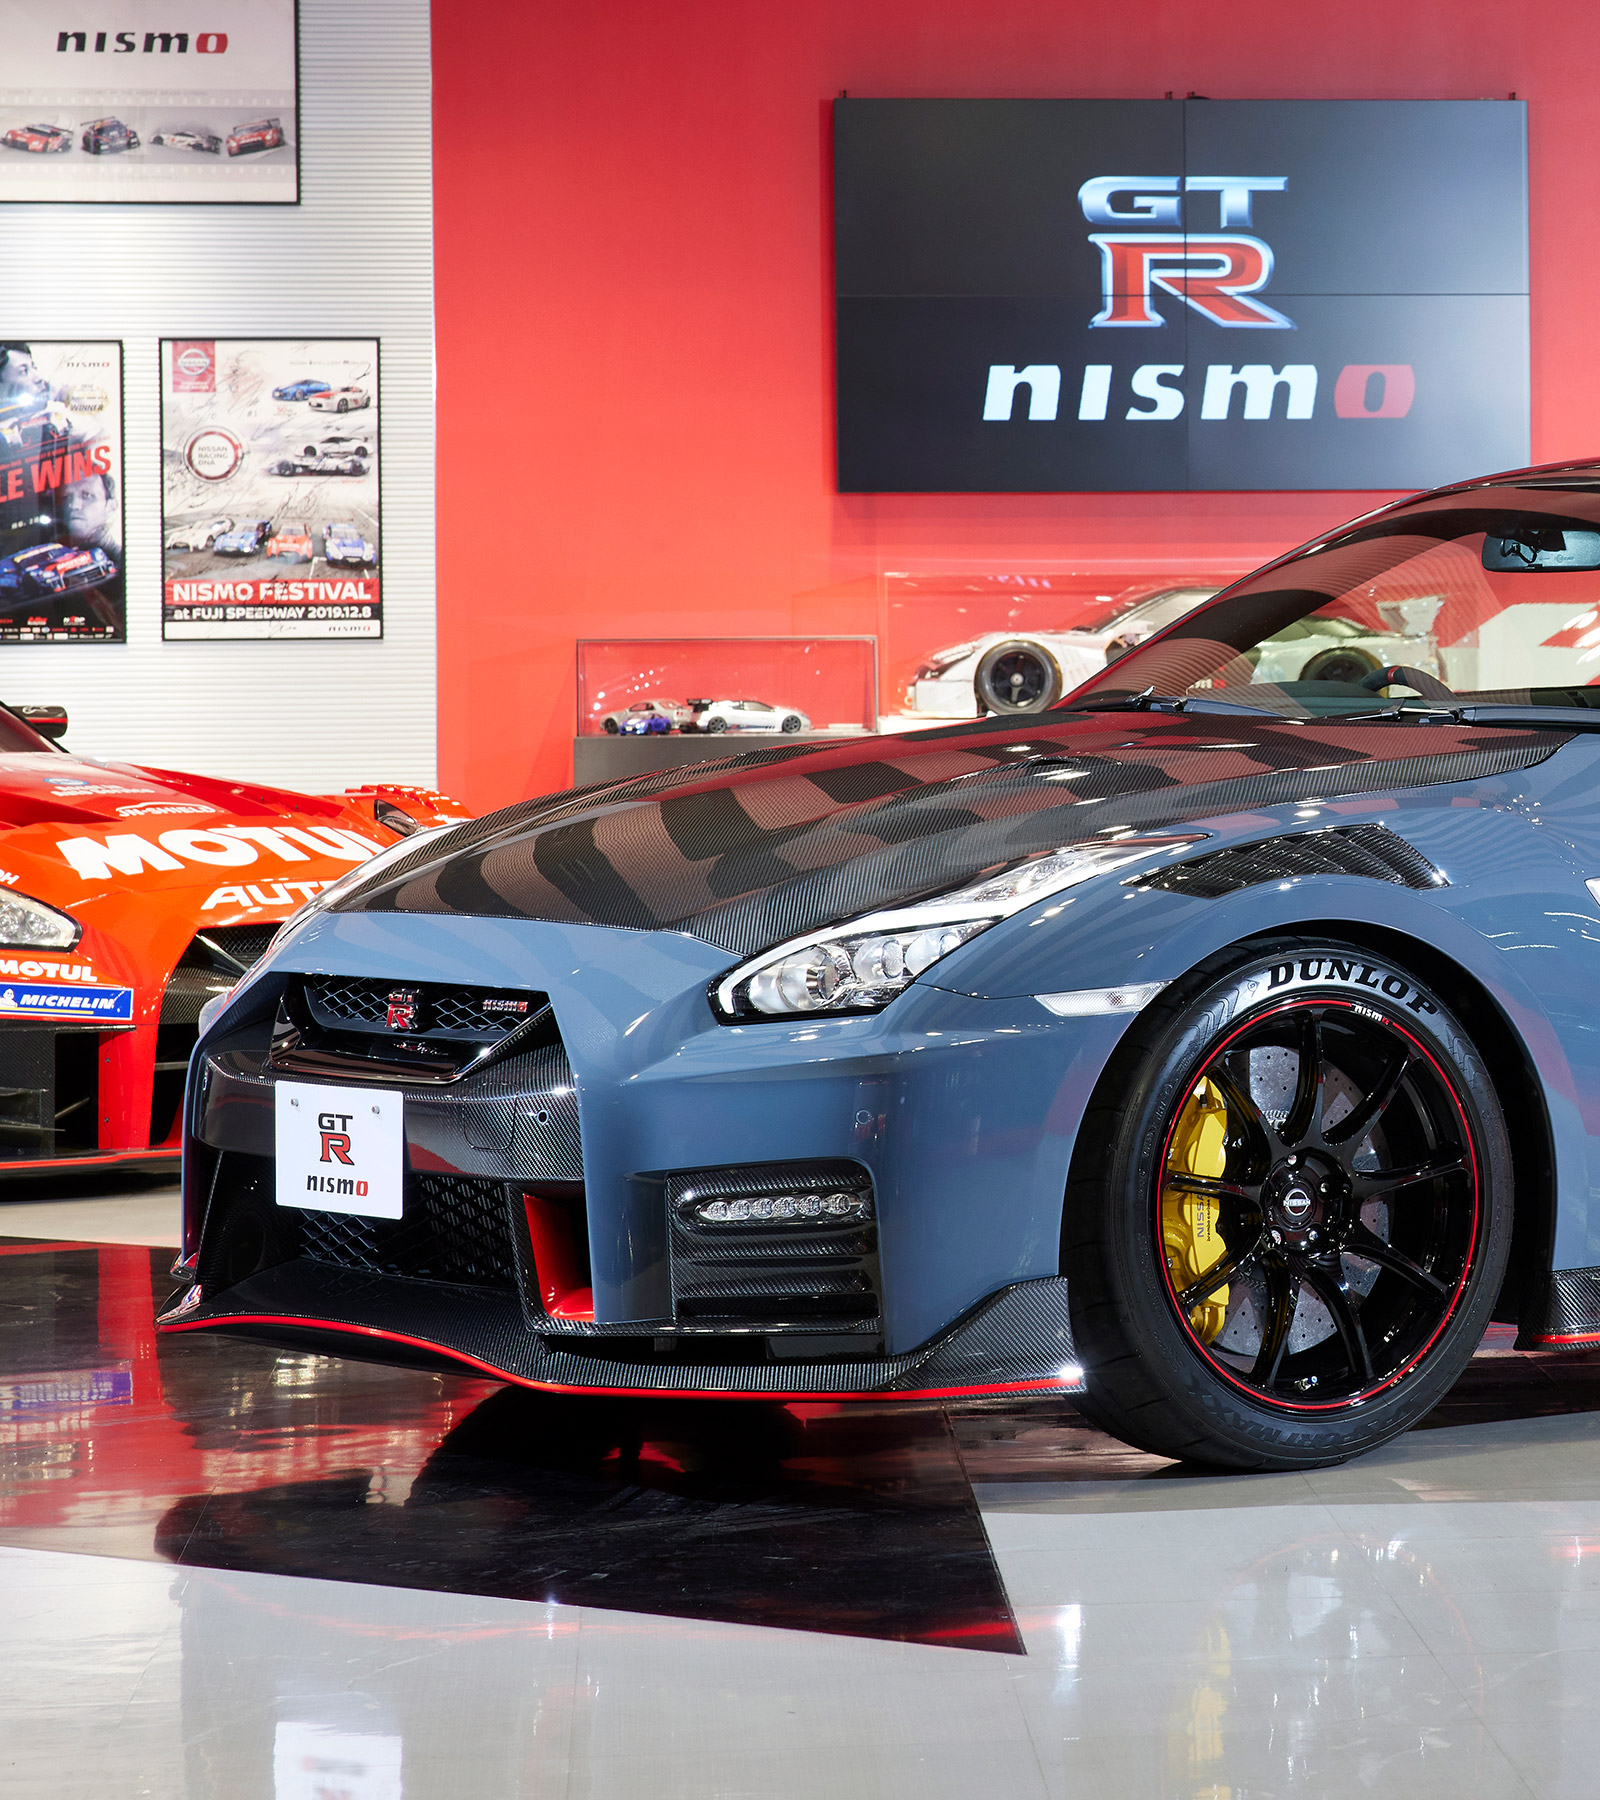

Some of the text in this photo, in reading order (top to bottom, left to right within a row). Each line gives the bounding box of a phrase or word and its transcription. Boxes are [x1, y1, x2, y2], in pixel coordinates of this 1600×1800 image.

[57, 31, 228, 54] nismo
[1077, 175, 1288, 228] GT
[1087, 233, 1298, 330] R
[983, 364, 1416, 421] nismo
[31, 445, 111, 494] WINS
[173, 582, 372, 602] NISMO FESTIVAL
[173, 606, 372, 620] at FUJI SPEEDWAY 2019.12.8
[0, 959, 98, 983] MOTUL
[1268, 957, 1438, 1017] DUNLOP
[20, 994, 115, 1010] MICHELIN
[482, 998, 529, 1013] nismo
[1353, 1003, 1390, 1026] nismo
[318, 1112, 353, 1132] GT
[319, 1132, 355, 1166] R
[306, 1175, 368, 1198] nismo
[1283, 1198, 1311, 1207] NISSAN
